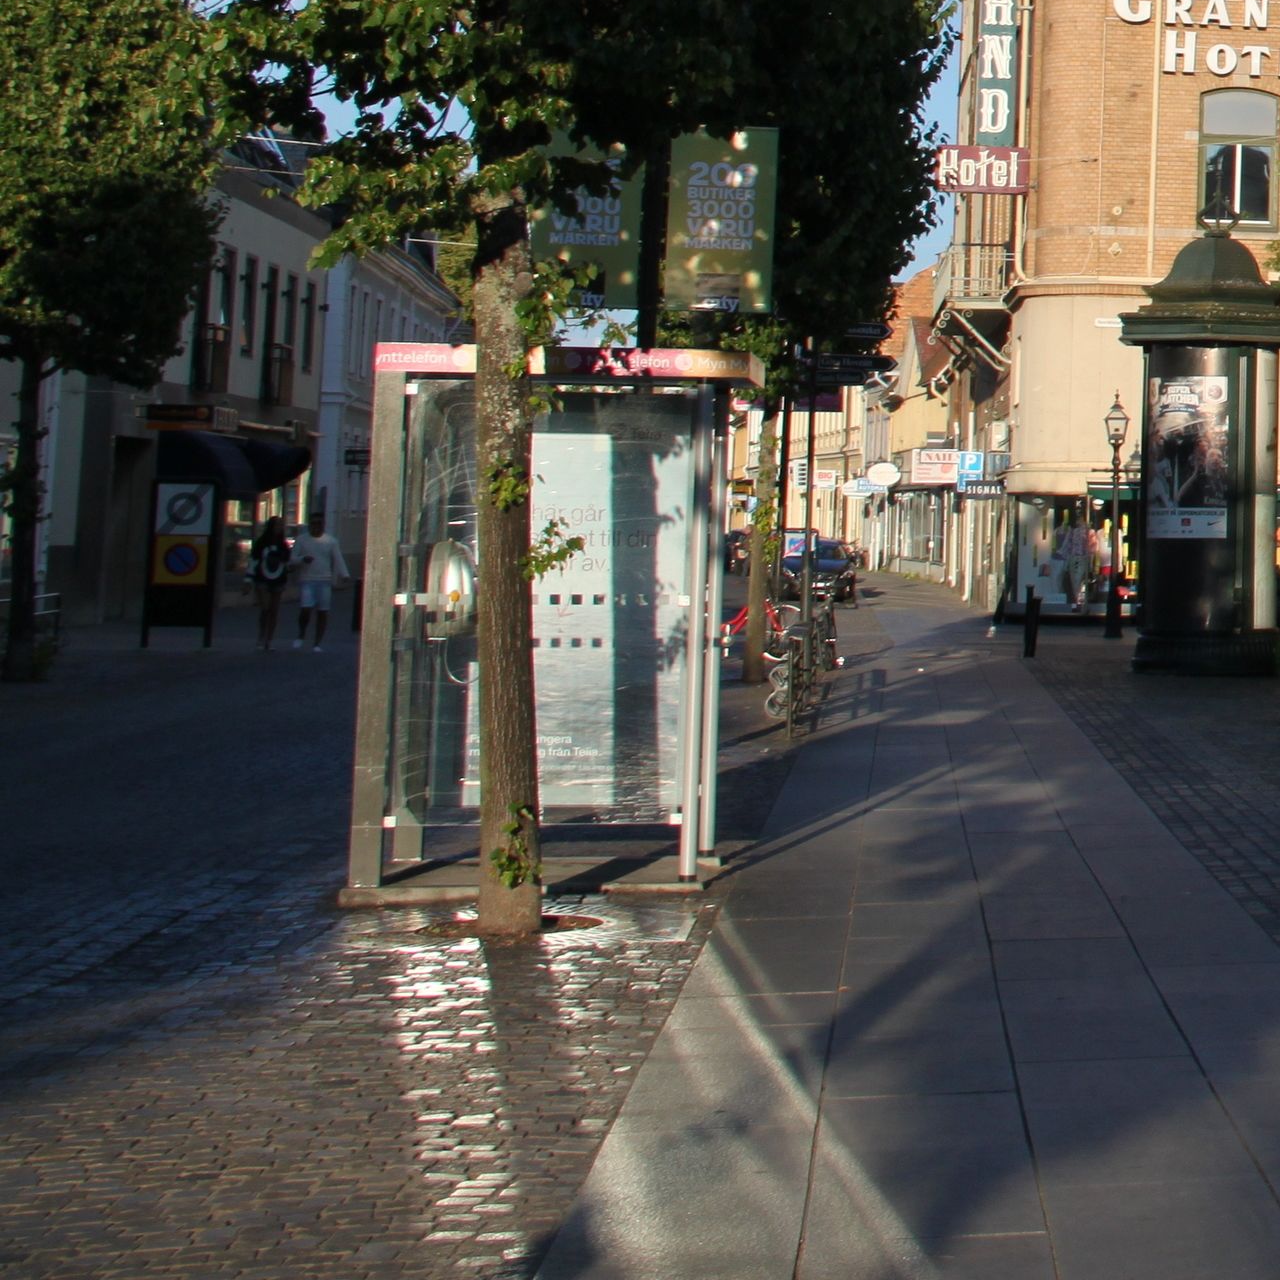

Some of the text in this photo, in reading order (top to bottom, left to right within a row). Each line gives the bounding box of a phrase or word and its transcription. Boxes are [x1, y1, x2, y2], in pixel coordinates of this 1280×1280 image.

[938, 149, 1019, 188] Hotel
[687, 187, 755, 200] BUTIKER
[687, 200, 754, 218] 3000
[965, 455, 977, 469] P
[967, 485, 1002, 494] SIGNAL
[571, 504, 606, 525] går
[582, 558, 611, 572] av.
